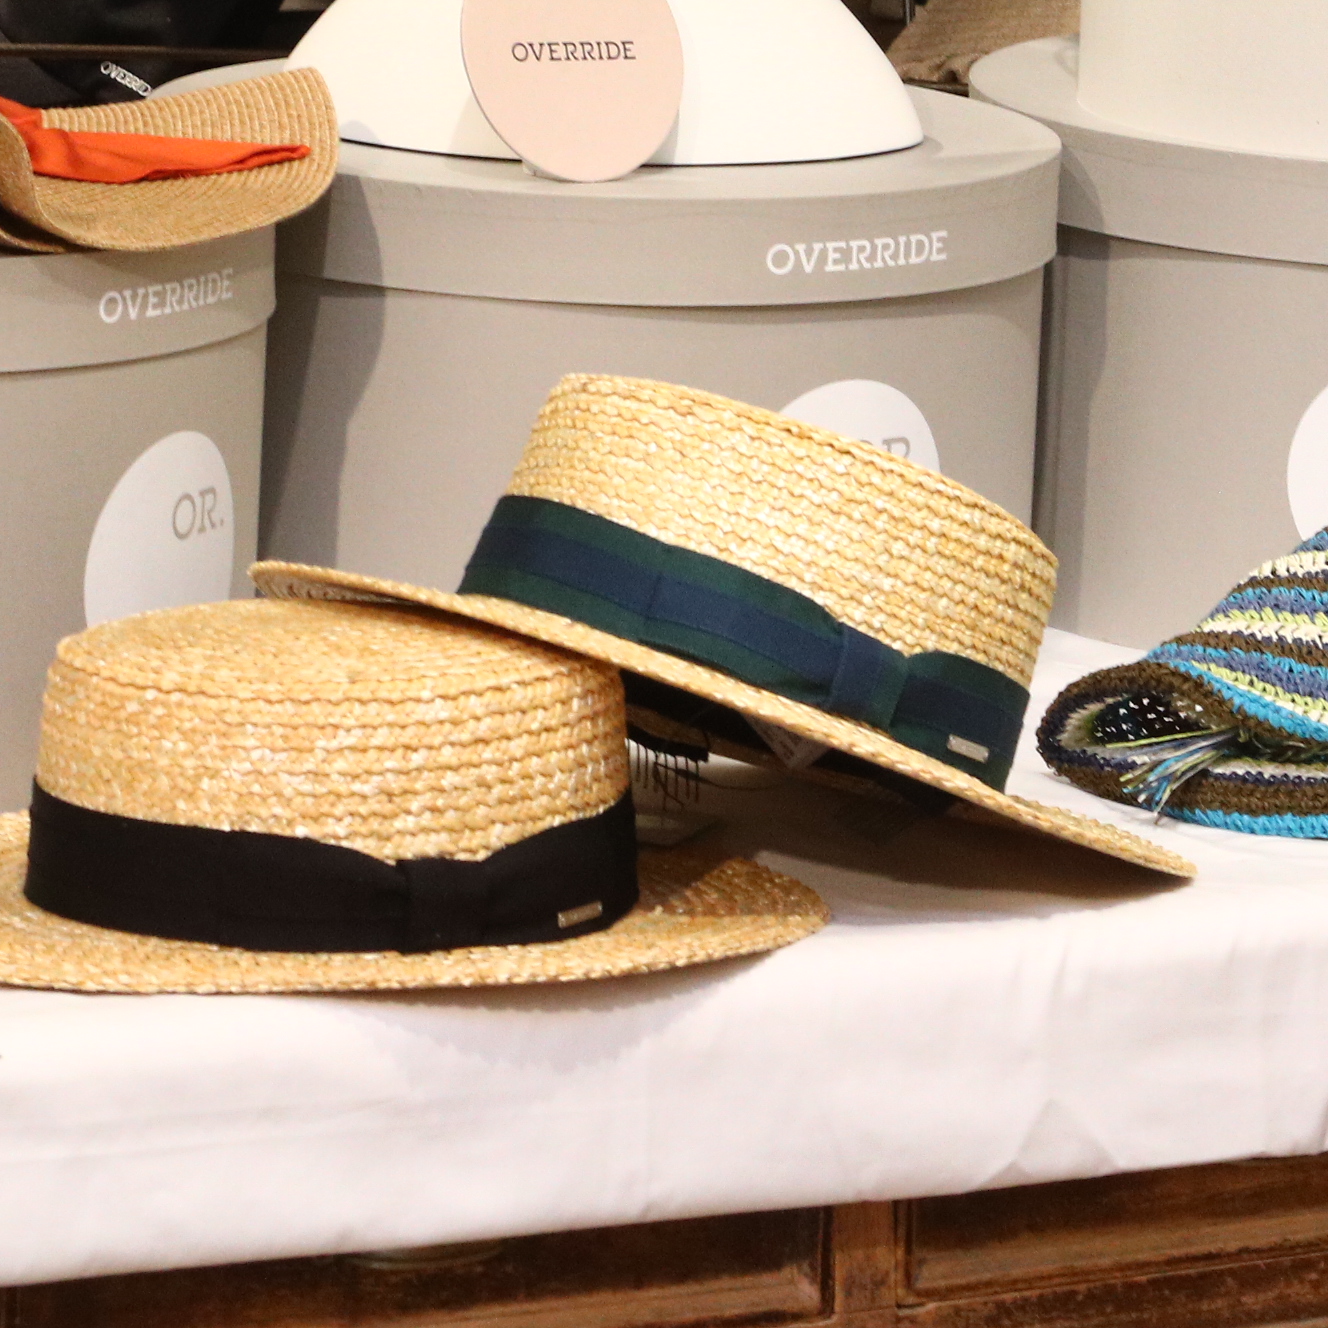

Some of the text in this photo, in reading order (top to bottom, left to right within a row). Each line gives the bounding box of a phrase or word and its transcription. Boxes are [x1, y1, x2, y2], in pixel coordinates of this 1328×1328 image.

[511, 40, 636, 62] OVERRIDE
[765, 229, 949, 275] OVERRIDE
[99, 267, 234, 324] OVERRIDE
[172, 485, 224, 541] OR.
